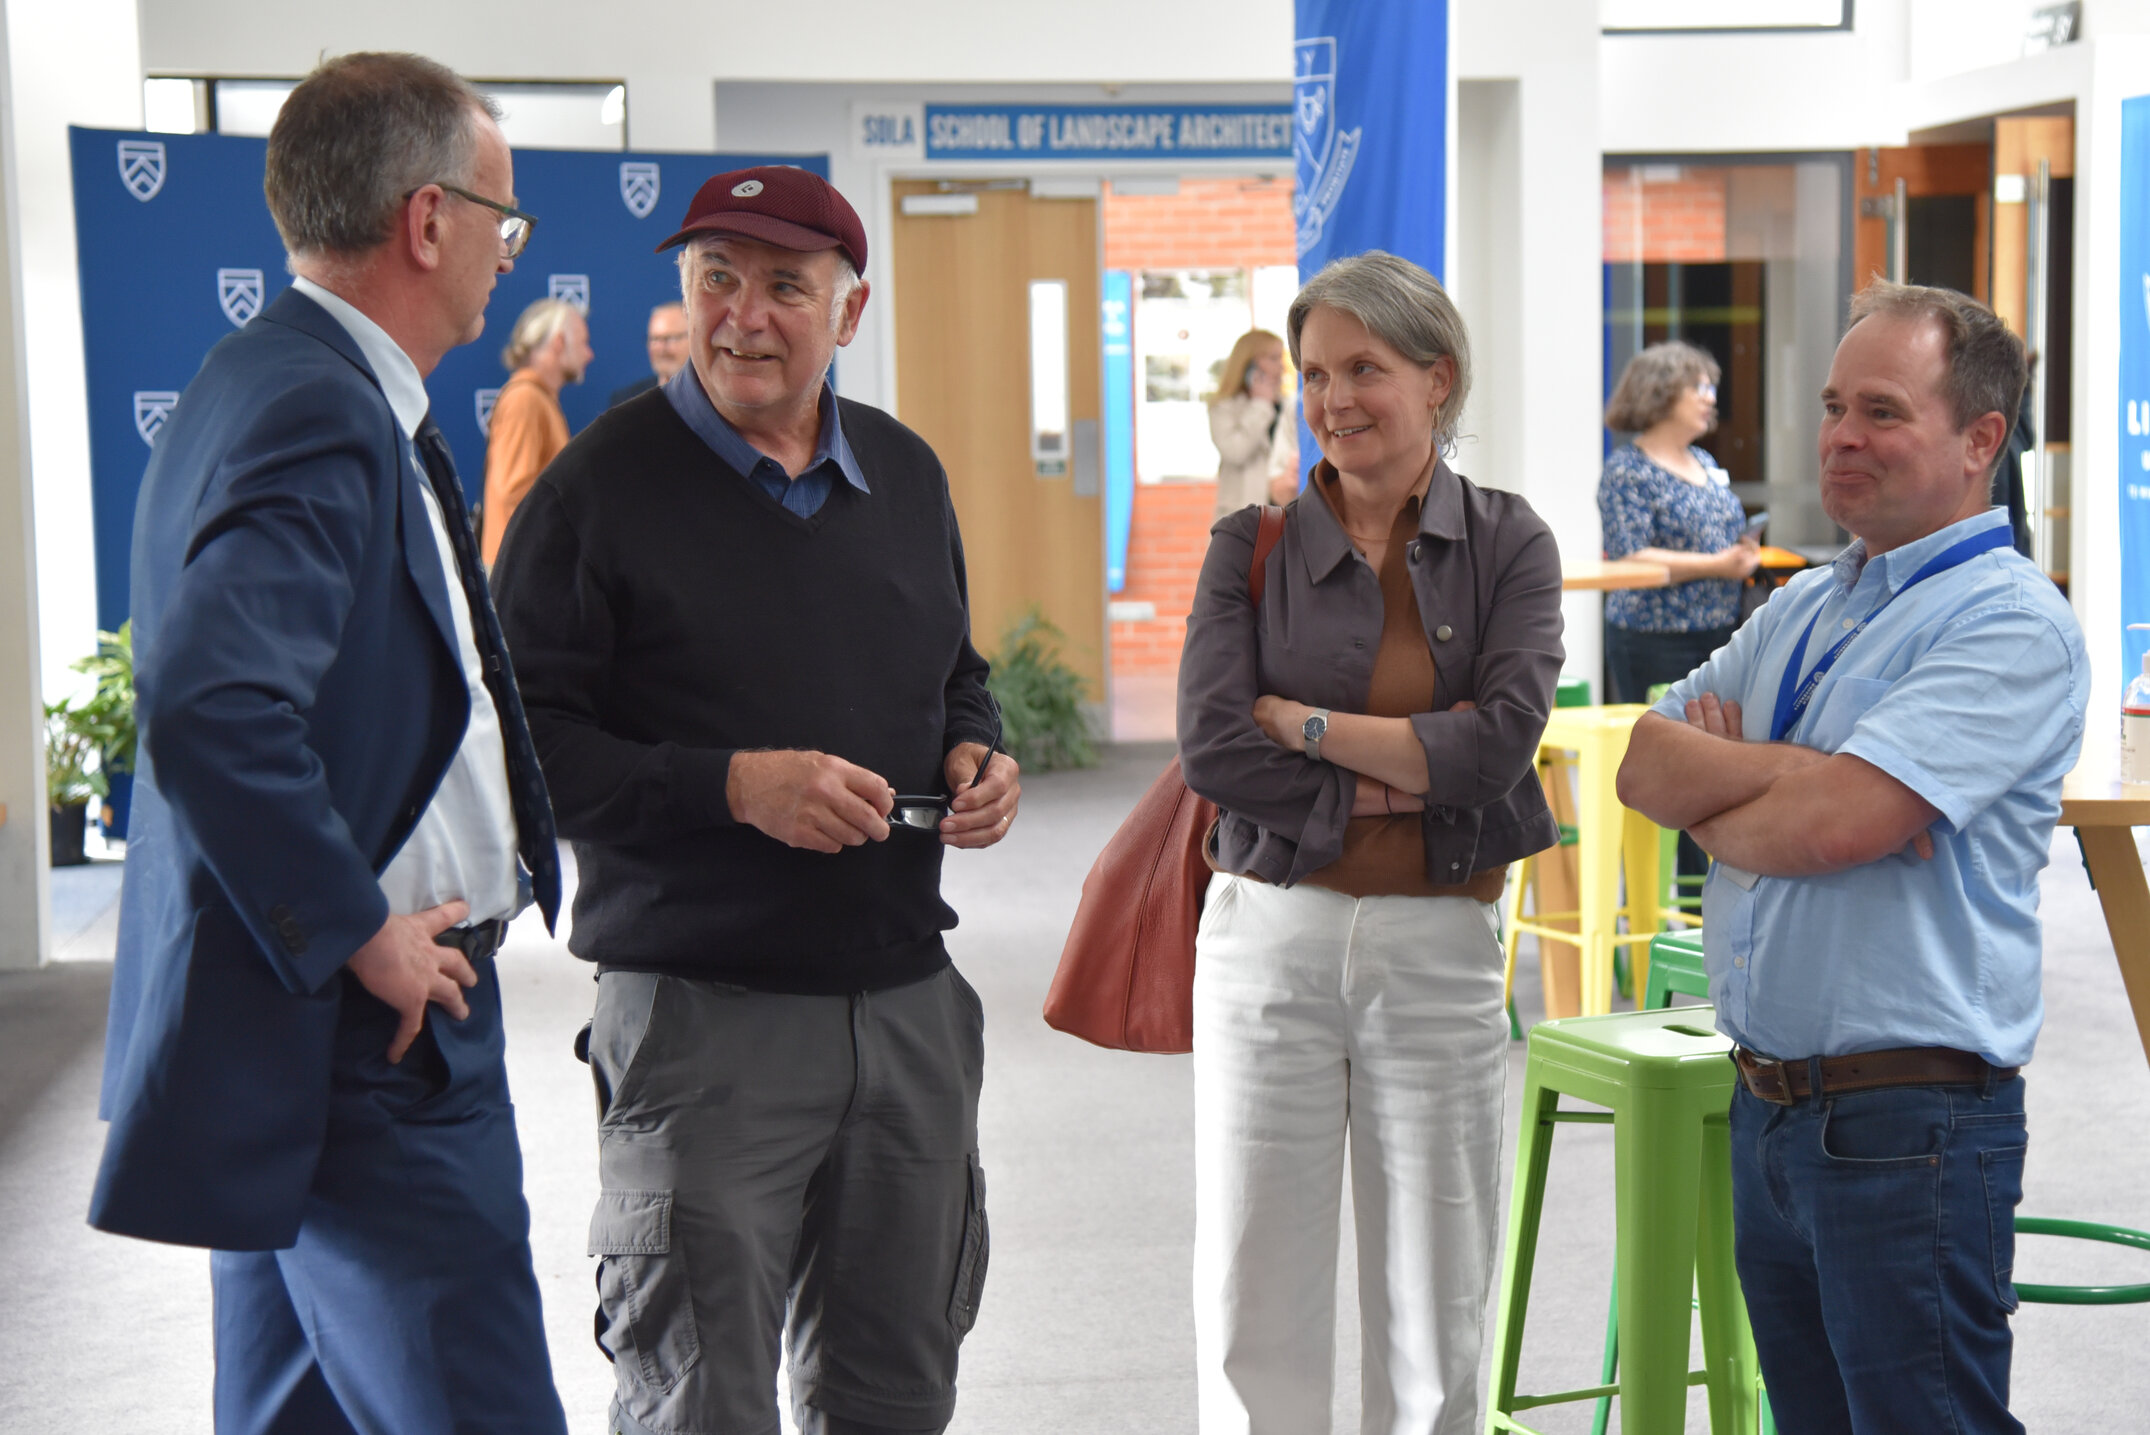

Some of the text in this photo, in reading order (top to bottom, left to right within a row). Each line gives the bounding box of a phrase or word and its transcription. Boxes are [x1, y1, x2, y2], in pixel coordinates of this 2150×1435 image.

[862, 115, 917, 146] SOLA
[930, 114, 1015, 149] SCHOOL
[1018, 114, 1046, 149] OF
[1049, 114, 1174, 149] LANDSCAPE
